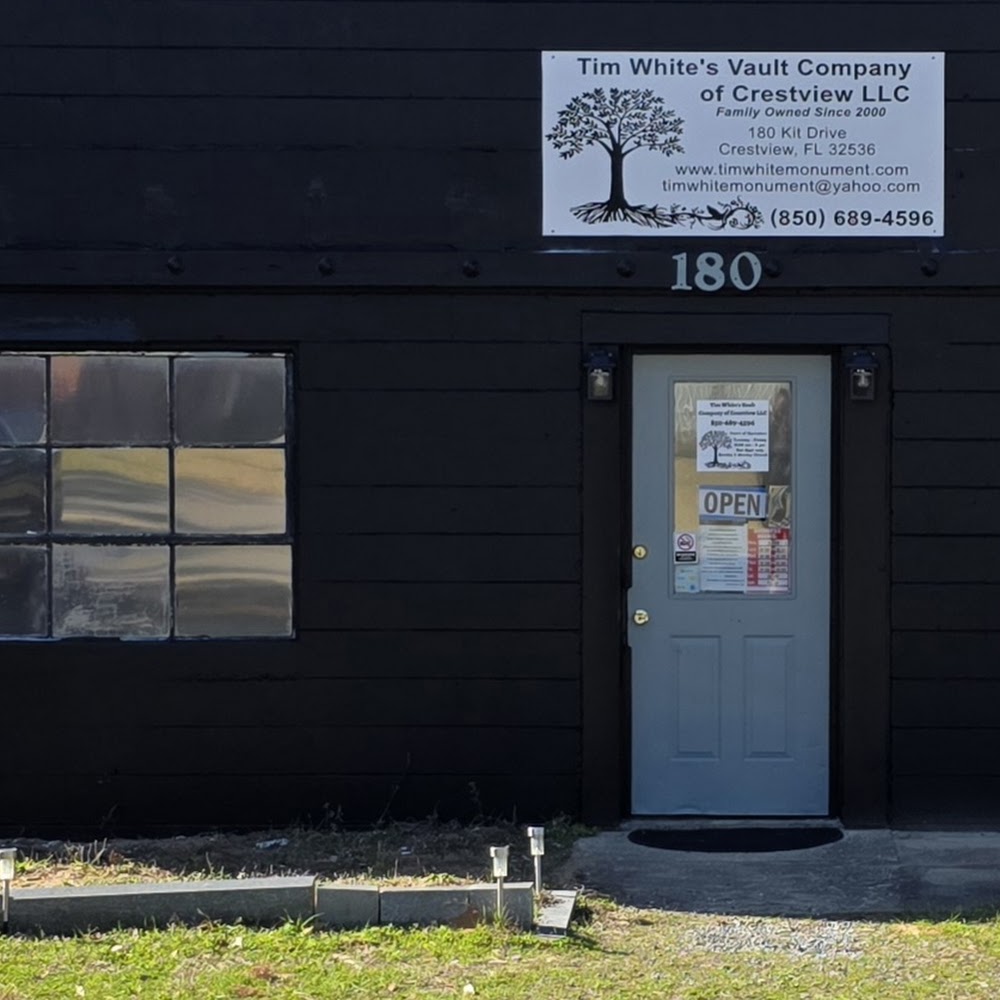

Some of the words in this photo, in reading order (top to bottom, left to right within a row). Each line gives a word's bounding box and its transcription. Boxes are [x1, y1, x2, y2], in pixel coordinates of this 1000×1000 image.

[577, 57, 621, 76] Tim
[629, 57, 719, 76] White's
[727, 58, 789, 77] Vault
[797, 58, 912, 81] Company
[699, 84, 725, 103] of
[732, 84, 854, 103] Crestview
[862, 84, 910, 103] LLC
[715, 106, 761, 120] Family
[764, 106, 811, 118] Owned
[814, 106, 852, 118] Since
[855, 106, 887, 118] 2000
[748, 126, 776, 139] 180
[781, 126, 802, 139] Kit
[806, 126, 847, 139] Drive
[718, 142, 798, 157] Crestview,
[803, 142, 823, 156] FL
[828, 142, 876, 156] 32536
[674, 162, 909, 176] www.timwhitemonument.com
[662, 179, 921, 195] timwhitemonument@yahoo.com
[770, 207, 826, 229] (850)
[833, 209, 934, 227] 689-4596
[671, 252, 762, 291] 180
[703, 491, 761, 516] OPEN
